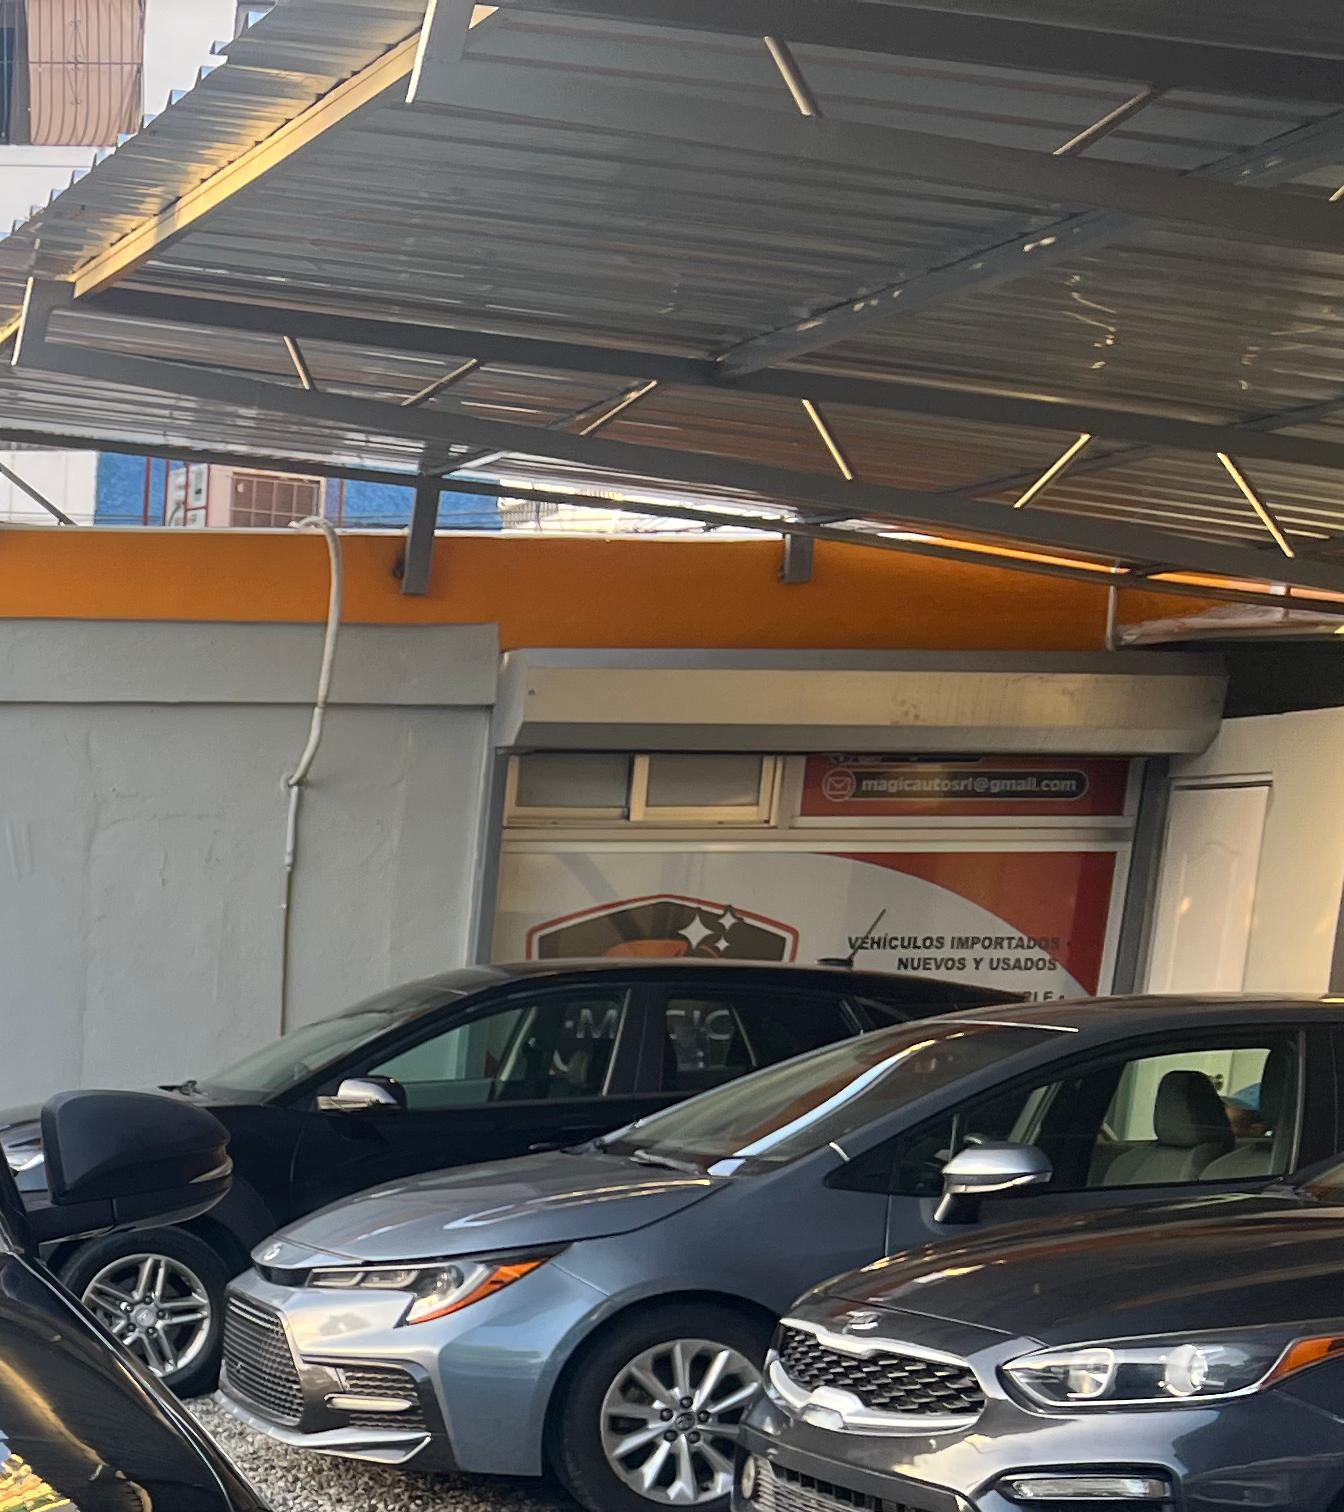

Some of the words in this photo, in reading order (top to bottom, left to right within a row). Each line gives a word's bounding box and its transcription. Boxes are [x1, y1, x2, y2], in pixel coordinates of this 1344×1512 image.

[861, 776, 1077, 793] magicautosrl@gmail.com
[847, 933, 945, 950] VEHÍCULOS
[950, 936, 1060, 950] IMPORTADOS
[896, 957, 967, 971] NUEVOS
[973, 957, 985, 971] Y
[989, 957, 1058, 971] USADOS
